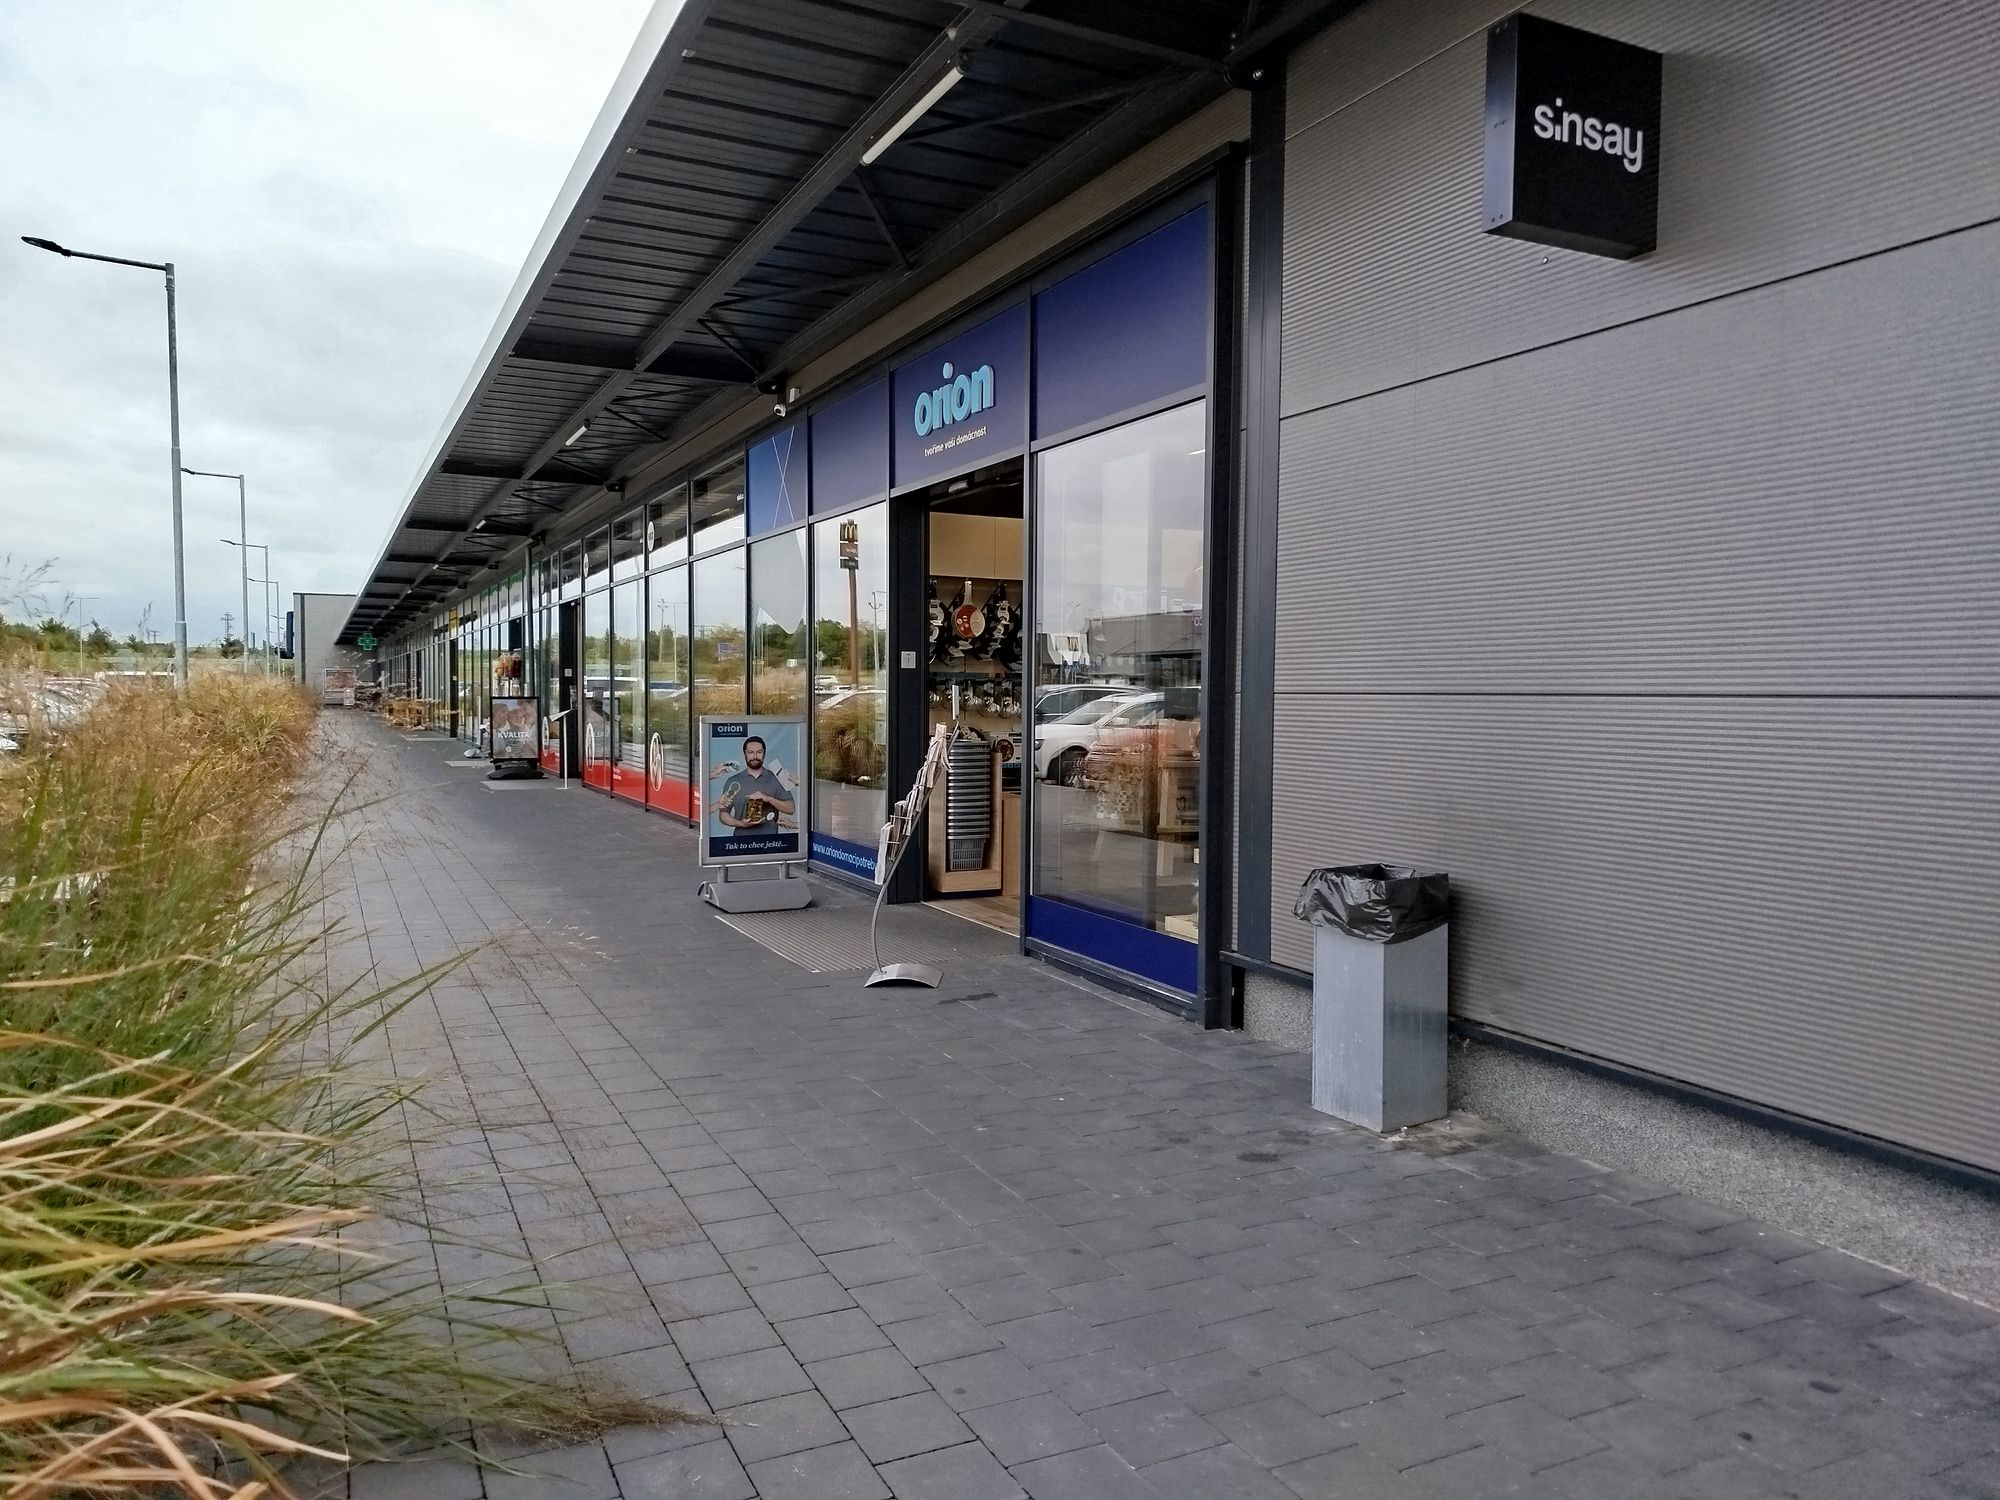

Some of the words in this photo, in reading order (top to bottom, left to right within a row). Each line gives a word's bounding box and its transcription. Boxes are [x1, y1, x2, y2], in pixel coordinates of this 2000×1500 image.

[1534, 97, 1643, 173] sinsay
[914, 362, 994, 437] orion
[717, 724, 743, 732] orion
[724, 842, 739, 850] Tak
[748, 841, 765, 849] chce
